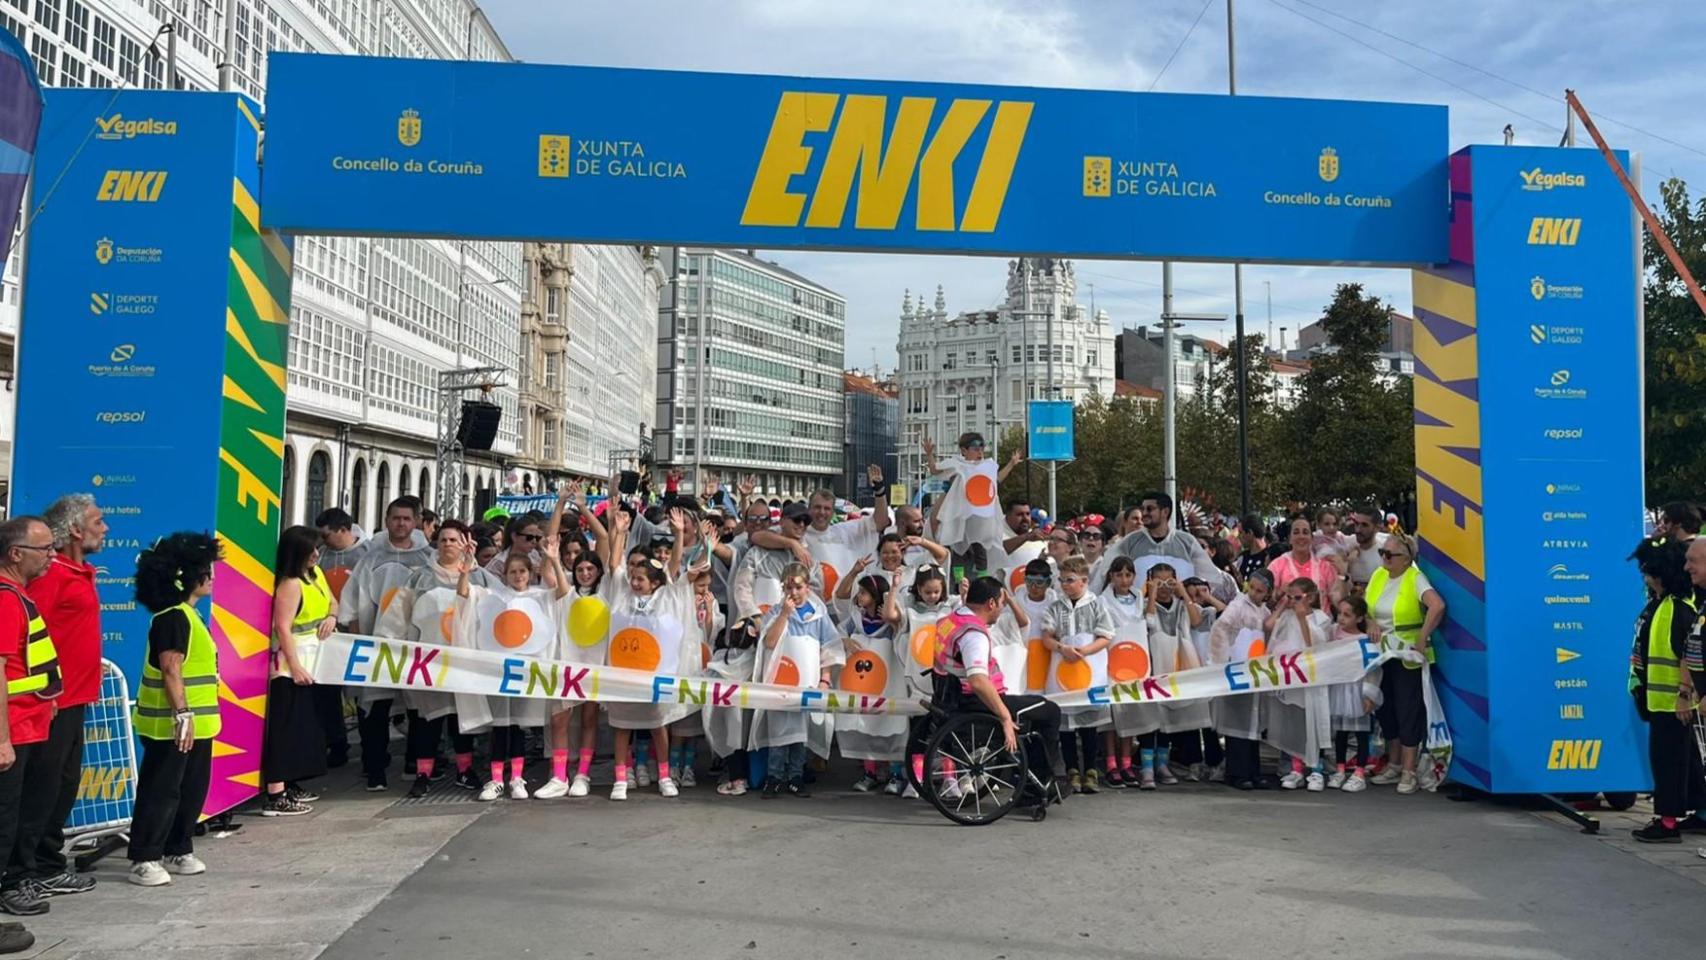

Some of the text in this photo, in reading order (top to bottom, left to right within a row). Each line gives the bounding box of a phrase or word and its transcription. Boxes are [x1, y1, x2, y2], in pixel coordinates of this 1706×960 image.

[96, 113, 177, 138] Vegalsa
[578, 140, 645, 158] XUNTA
[332, 156, 484, 175] Concello da Coruña
[576, 159, 687, 178] DE GALICIA
[740, 91, 1035, 233] ENKI
[1118, 161, 1179, 177] XUNTA
[96, 170, 168, 202] ENKI
[1520, 167, 1585, 189] Vegalsa
[1117, 180, 1217, 197] DE GALICIA
[1264, 191, 1392, 208] Concello da Coruña
[1527, 217, 1582, 246] ENKI
[116, 247, 163, 256] Deputación
[117, 295, 158, 303] DEPORTE
[116, 305, 155, 314] GALEGO
[96, 411, 146, 424] repsol
[1544, 428, 1583, 439] repsol
[1543, 540, 1588, 548] ATREVIA
[102, 632, 124, 641] STIL
[343, 639, 450, 688] ENKI
[1225, 650, 1317, 691] ENKI
[499, 658, 609, 700] ENKI
[1554, 678, 1587, 689] gestán
[1547, 740, 1602, 769] ENKI
[75, 766, 134, 800] NKI
